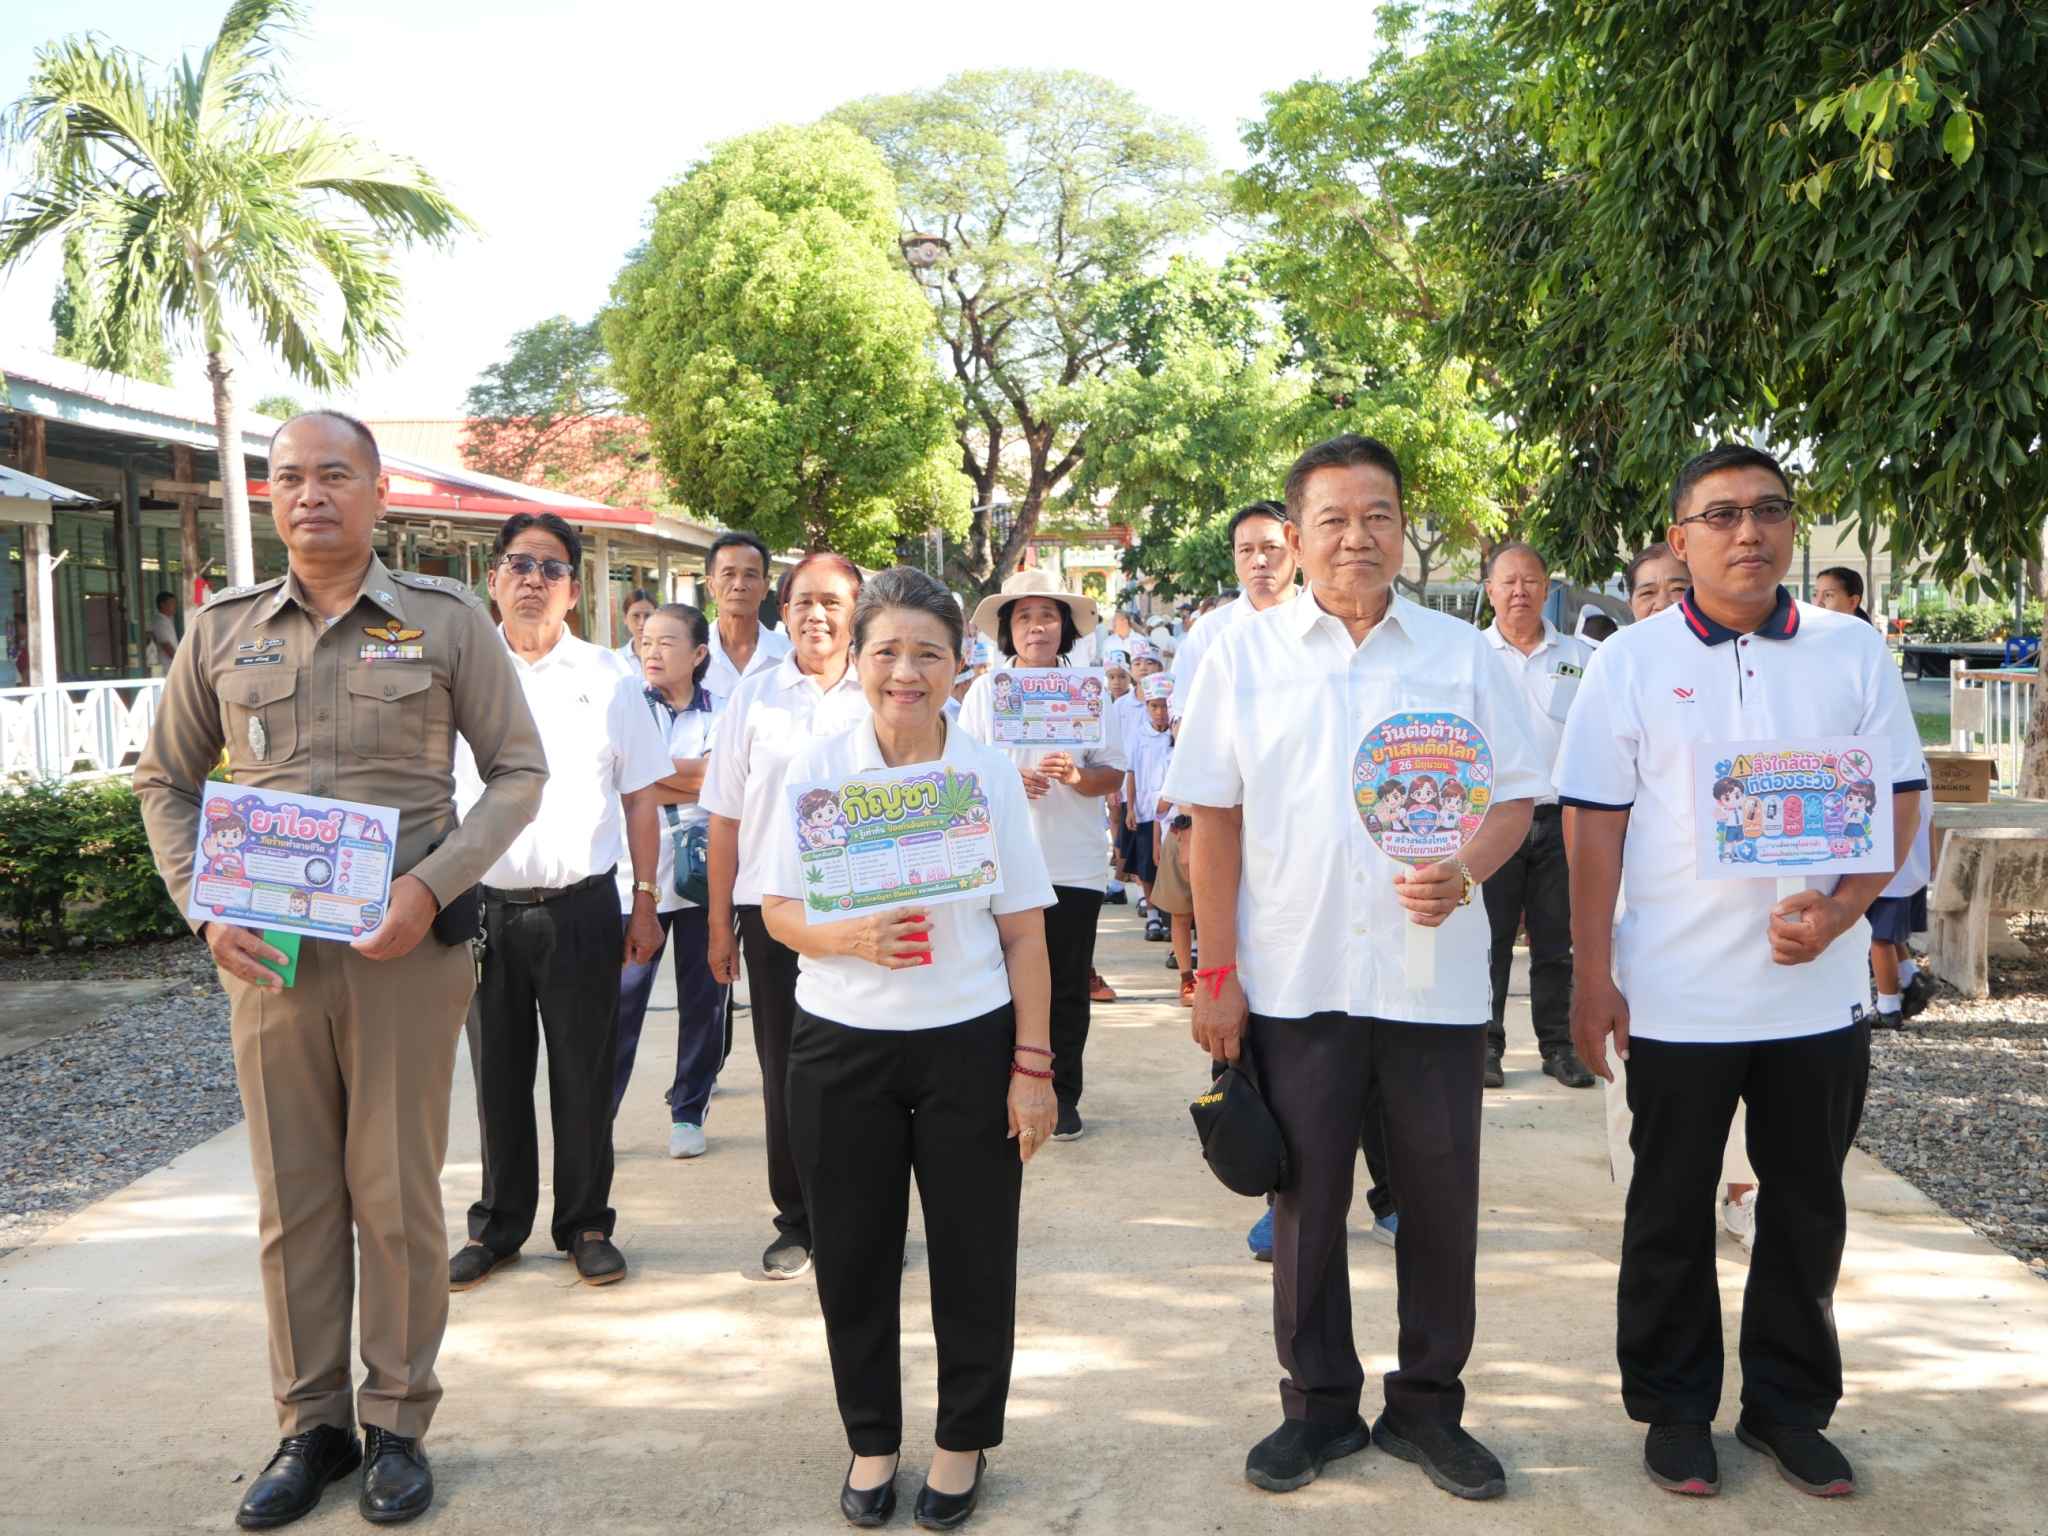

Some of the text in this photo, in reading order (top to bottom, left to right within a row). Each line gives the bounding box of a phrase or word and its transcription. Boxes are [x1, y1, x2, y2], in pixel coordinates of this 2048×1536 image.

[1023, 672, 1068, 693] ยาบ้า
[1380, 719, 1469, 743] วันต่อต้าน
[1372, 739, 1478, 764] ยาเสพติดโลก
[1752, 753, 1822, 773] สิ่งใกล้ตัว
[1398, 760, 1412, 771] 26
[1748, 771, 1836, 795] ที่ต้องระวัง
[843, 779, 939, 825] กัญชา
[250, 804, 343, 843] ยาไอซ์
